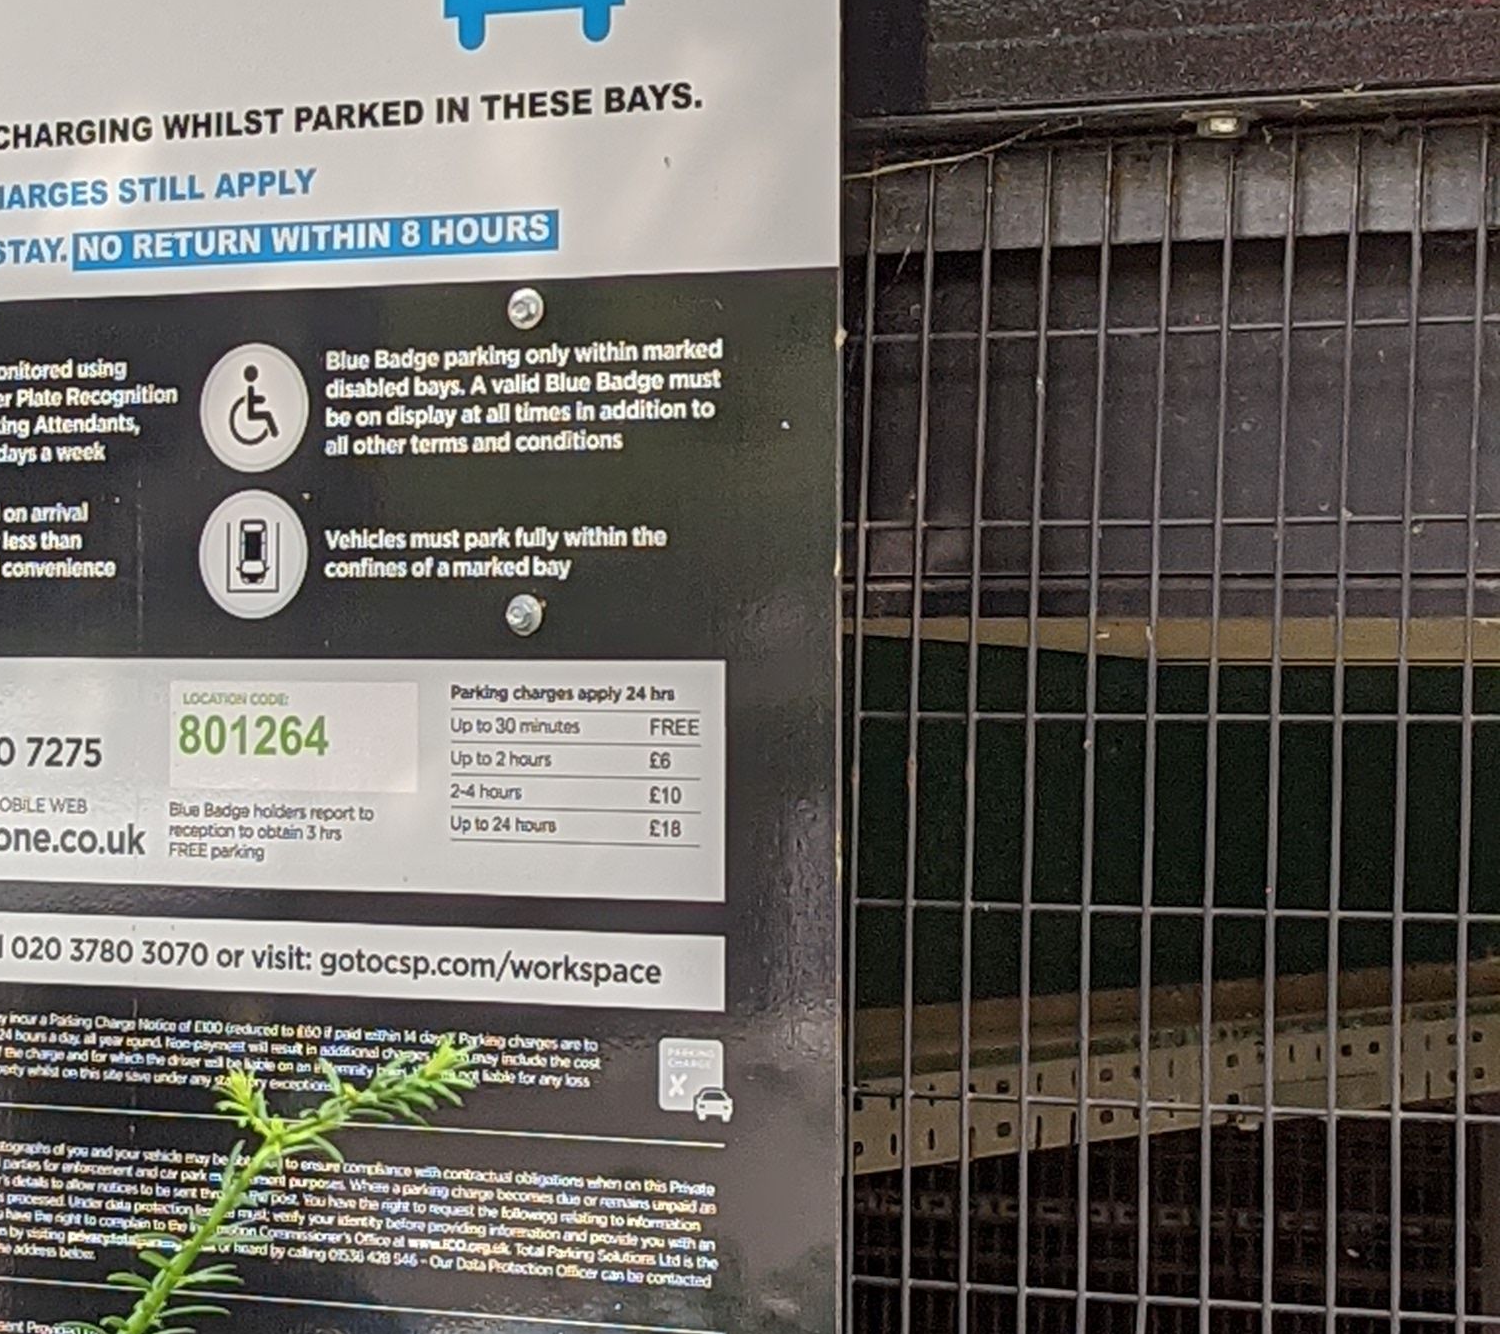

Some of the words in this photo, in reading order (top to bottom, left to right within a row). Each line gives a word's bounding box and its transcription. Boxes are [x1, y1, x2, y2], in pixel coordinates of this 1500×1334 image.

[162, 107, 284, 141] WHILST
[294, 99, 424, 134] PARKED
[436, 95, 469, 125] IN
[480, 87, 593, 122] THESE
[604, 81, 703, 115] BAYS.
[119, 174, 205, 205] STILL
[214, 167, 317, 200] APPLY
[78, 232, 122, 262] NO
[133, 227, 261, 260] RETURN
[271, 219, 390, 253] WITHIN
[401, 219, 421, 248] 8
[431, 212, 550, 246] HOURS
[325, 350, 370, 372] Blue
[374, 348, 440, 373] Badge
[443, 343, 521, 372] parking
[524, 342, 571, 368] only
[573, 340, 639, 364] within
[642, 337, 723, 362] marked
[76, 357, 127, 382] using
[16, 386, 63, 408] Plate
[65, 382, 178, 409] Recognition
[33, 412, 141, 437] Attendants,
[40, 445, 53, 463] a
[55, 439, 106, 463] week
[2, 506, 28, 524] on
[30, 501, 89, 524] arrival
[450, 683, 509, 704] Parking
[512, 684, 575, 704] charges
[577, 685, 622, 705] apply
[625, 685, 647, 702] 24
[649, 685, 675, 702] hrs
[179, 713, 329, 757] 801264
[450, 717, 474, 736] Up
[476, 718, 493, 735] to
[495, 715, 517, 736] 30
[519, 717, 581, 735] minutes
[650, 717, 700, 737] FREE
[26, 735, 102, 769] 7275
[450, 749, 474, 769] Up
[476, 750, 493, 768] to
[495, 750, 506, 768] 2
[509, 750, 552, 768] hours
[649, 750, 672, 770] £6
[450, 781, 476, 800] 2-4
[479, 782, 522, 802] hours
[649, 784, 682, 805] £10
[450, 814, 472, 836] Up
[474, 816, 489, 833] to
[492, 815, 511, 833] 24
[515, 816, 557, 834] hours
[649, 817, 682, 838] £18
[11, 935, 62, 962] 020
[70, 937, 134, 964] 3780
[141, 939, 209, 967] 3070
[216, 947, 245, 970] or
[251, 943, 312, 971] visit:
[319, 947, 662, 988] gotocsp.com/workspace
